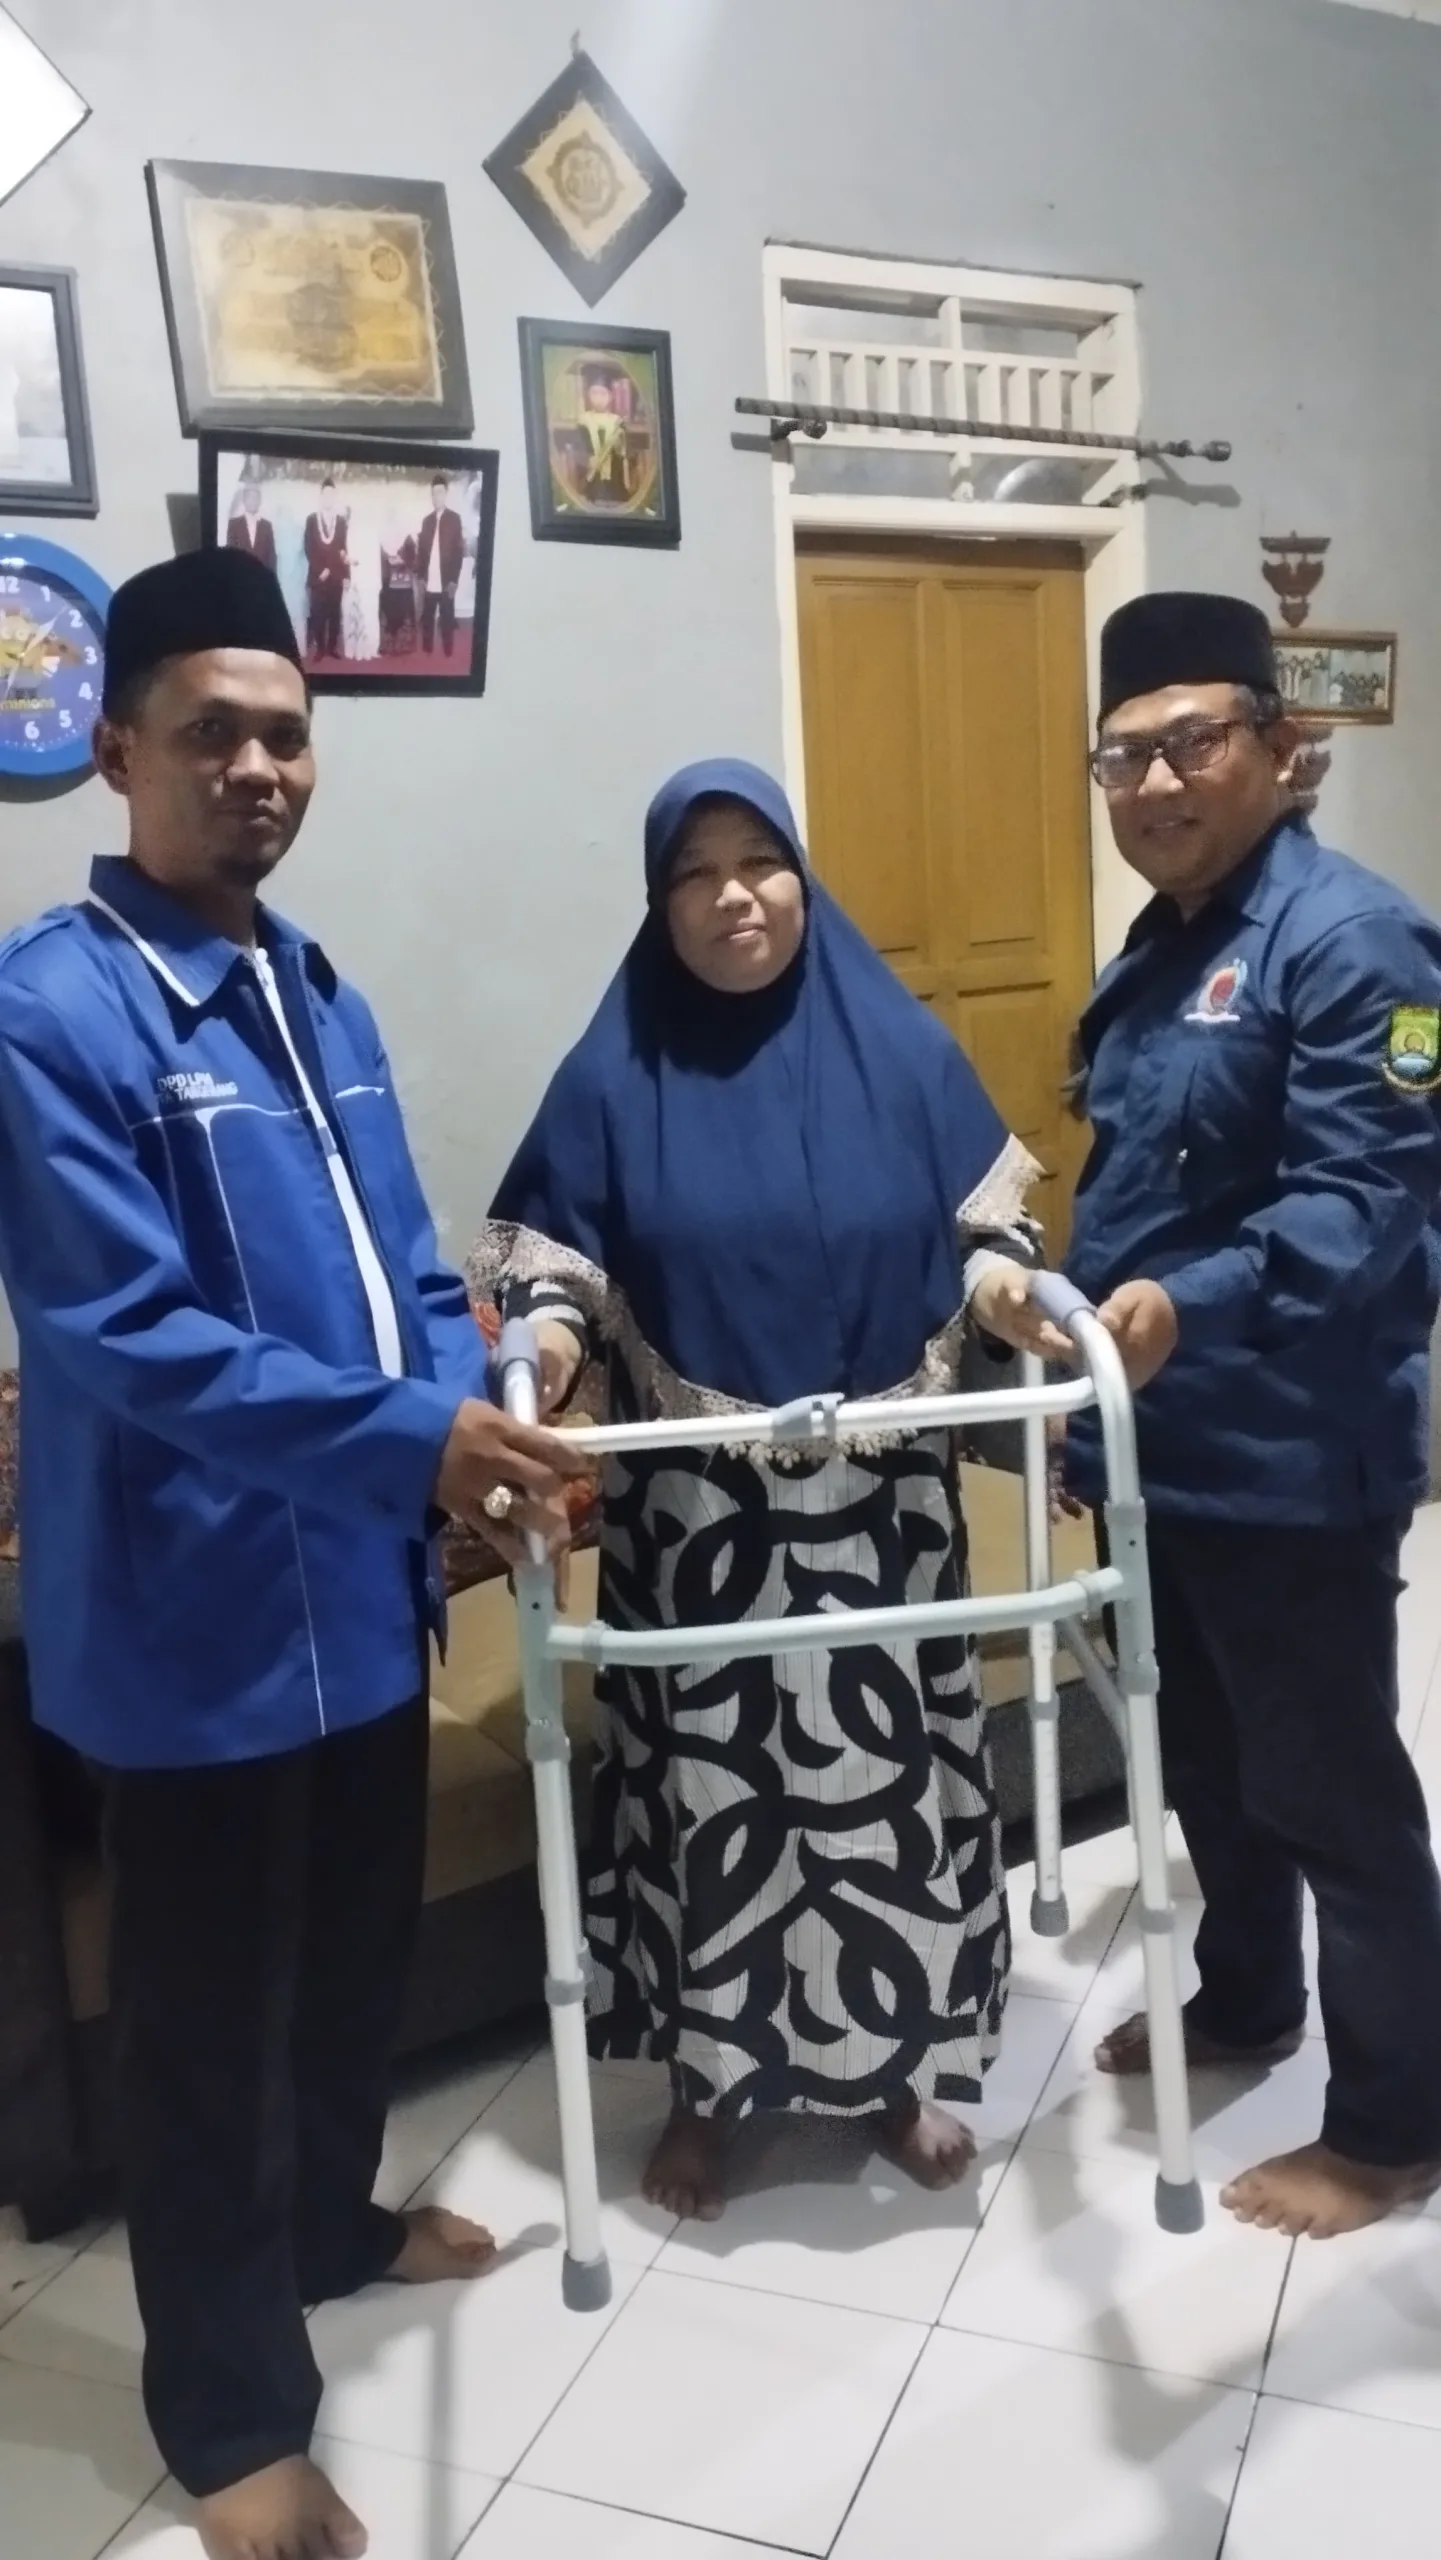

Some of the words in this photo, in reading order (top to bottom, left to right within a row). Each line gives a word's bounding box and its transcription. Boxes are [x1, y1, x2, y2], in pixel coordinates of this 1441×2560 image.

[0, 575, 20, 593] 12
[41, 585, 51, 602] 1
[68, 609, 83, 628] 2
[84, 645, 98, 665] 3
[79, 681, 93, 700] 4
[59, 709, 72, 728] 5
[25, 720, 40, 739] 6
